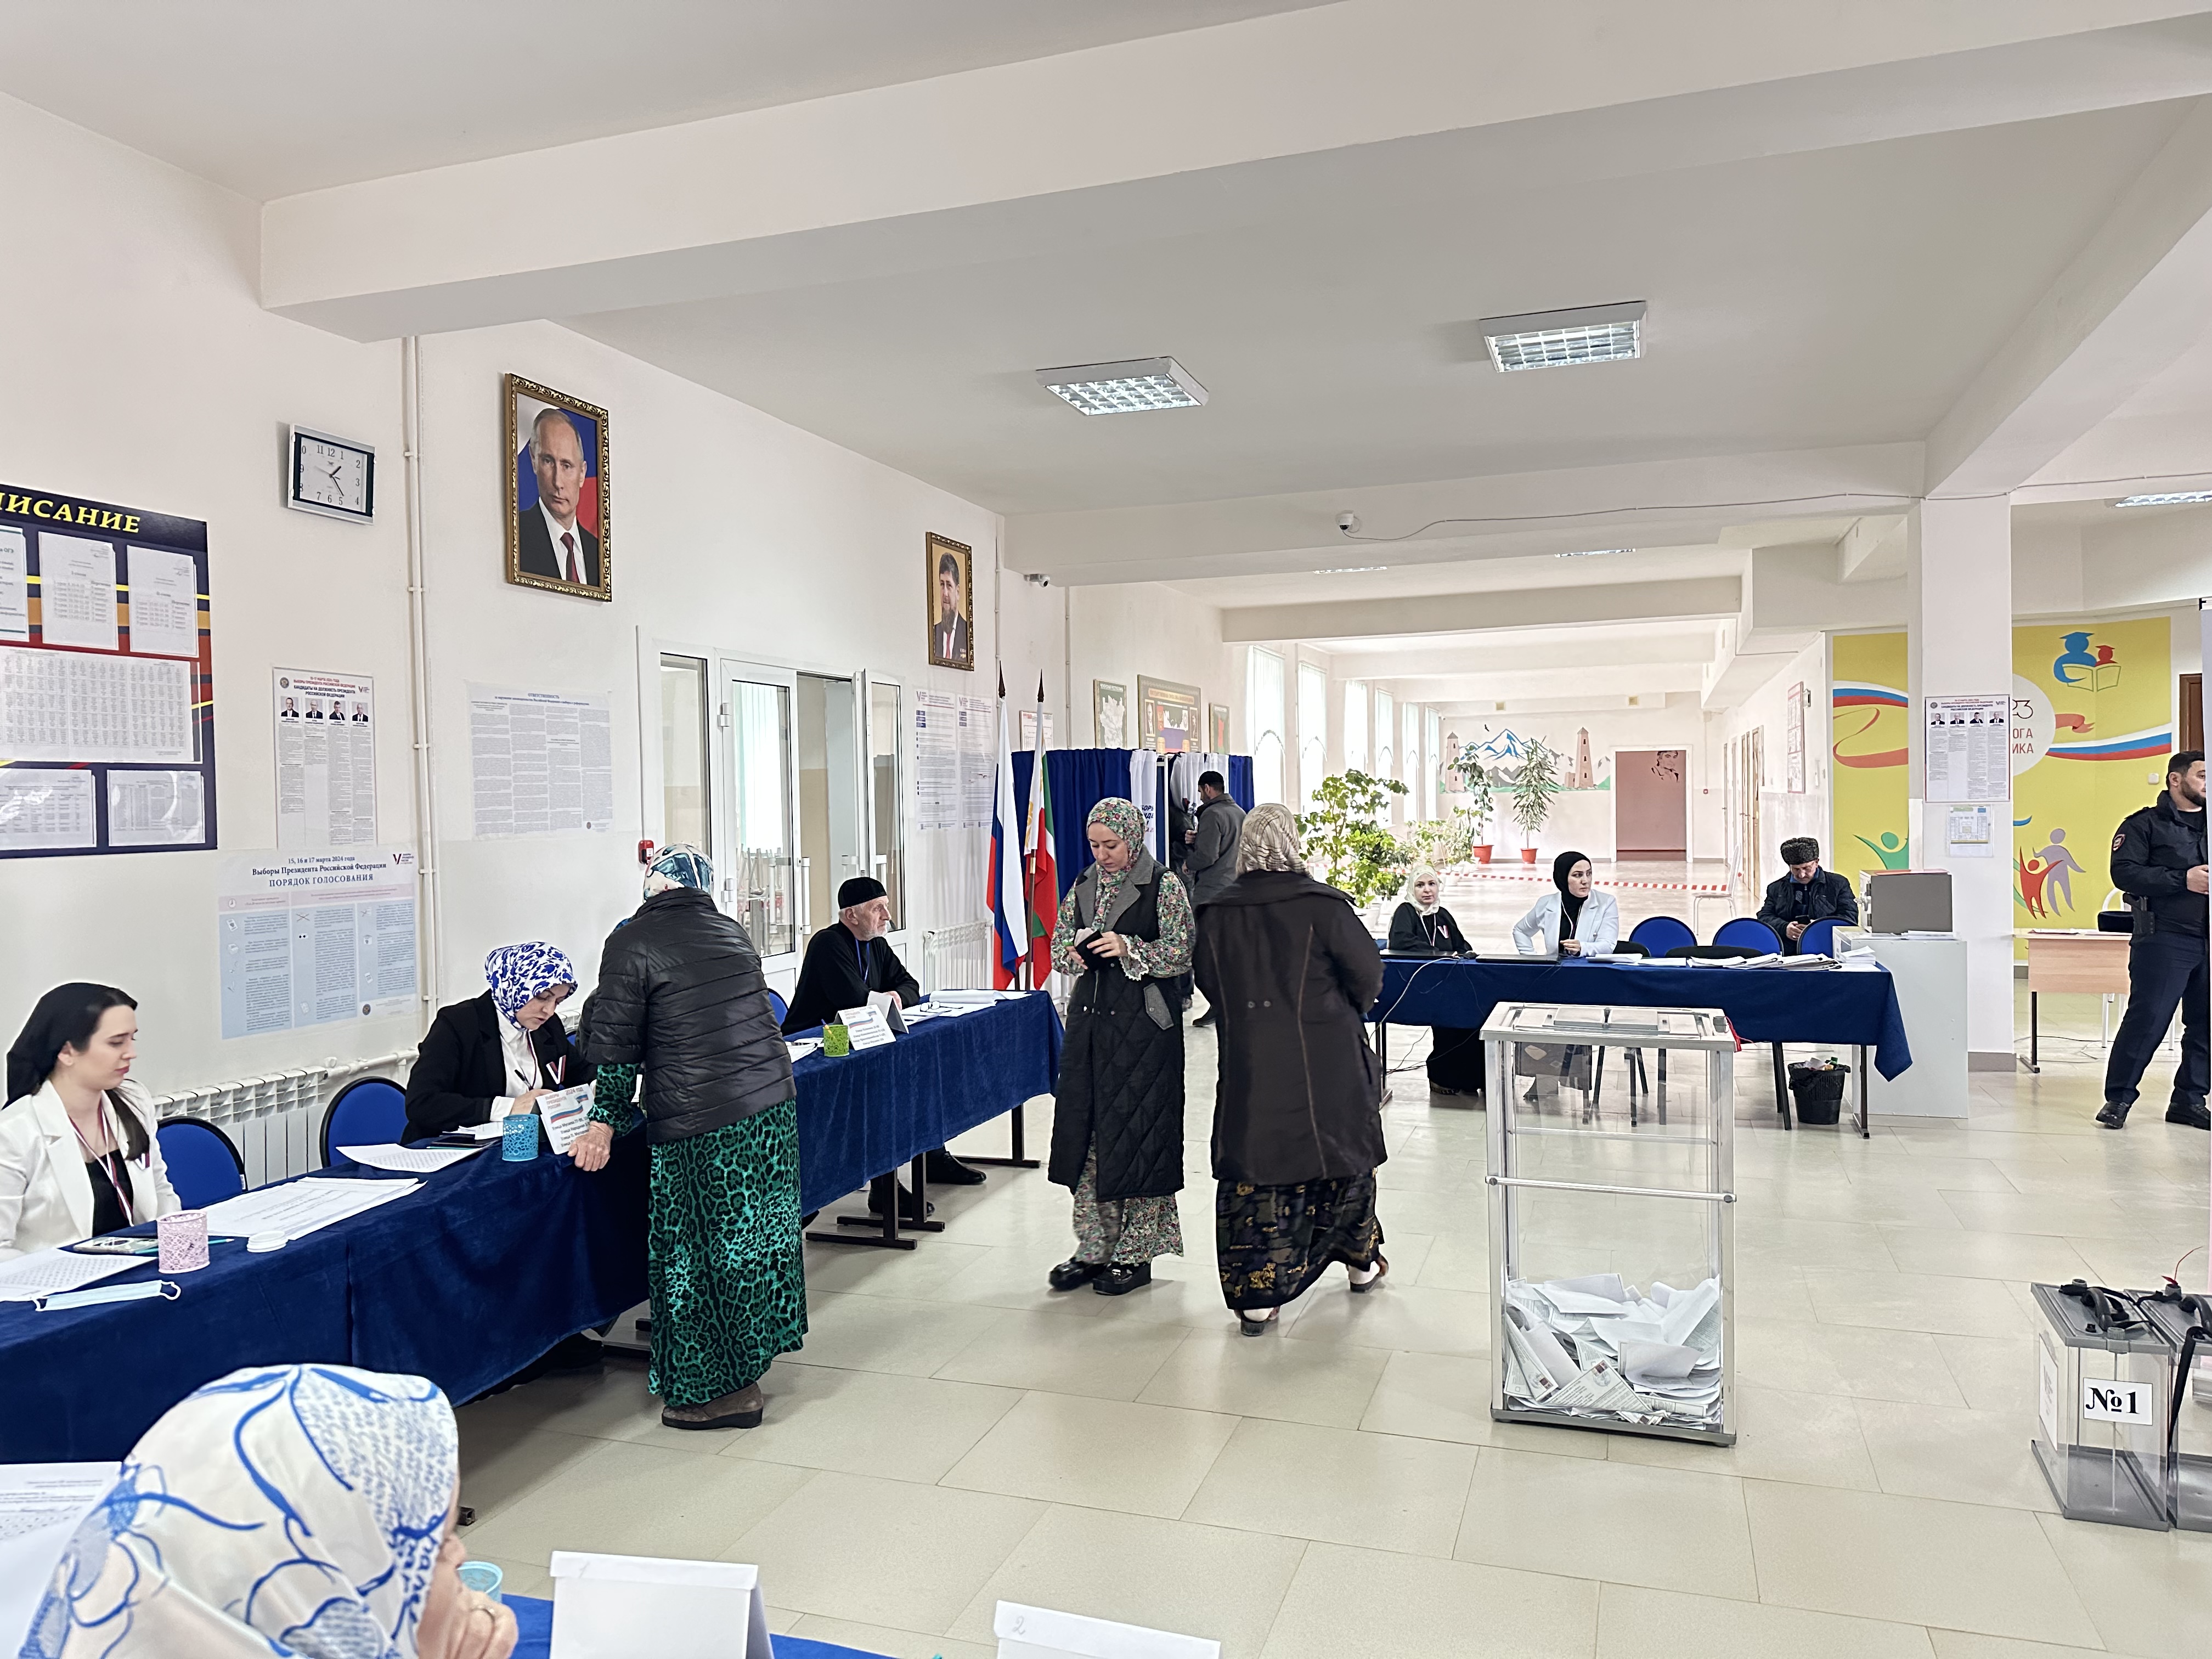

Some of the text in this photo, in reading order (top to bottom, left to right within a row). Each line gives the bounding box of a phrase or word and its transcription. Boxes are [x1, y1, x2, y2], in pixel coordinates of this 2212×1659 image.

[317, 445, 324, 454] 11
[328, 448, 335, 458] 12
[340, 450, 344, 460] 1
[356, 460, 360, 469] 2
[356, 478, 360, 487] 3
[317, 492, 321, 500] 7
[328, 495, 332, 503] 6
[355, 496, 359, 505] 4
[338, 497, 343, 505] 5
[0, 492, 141, 533] ИСАНИЕ
[252, 862, 387, 876] Выборы Президента Российской Федерации
[269, 873, 374, 888] ПОРЯДОК ГОЛОСОВАНИЯ
[1012, 1615, 1025, 1635] 2
